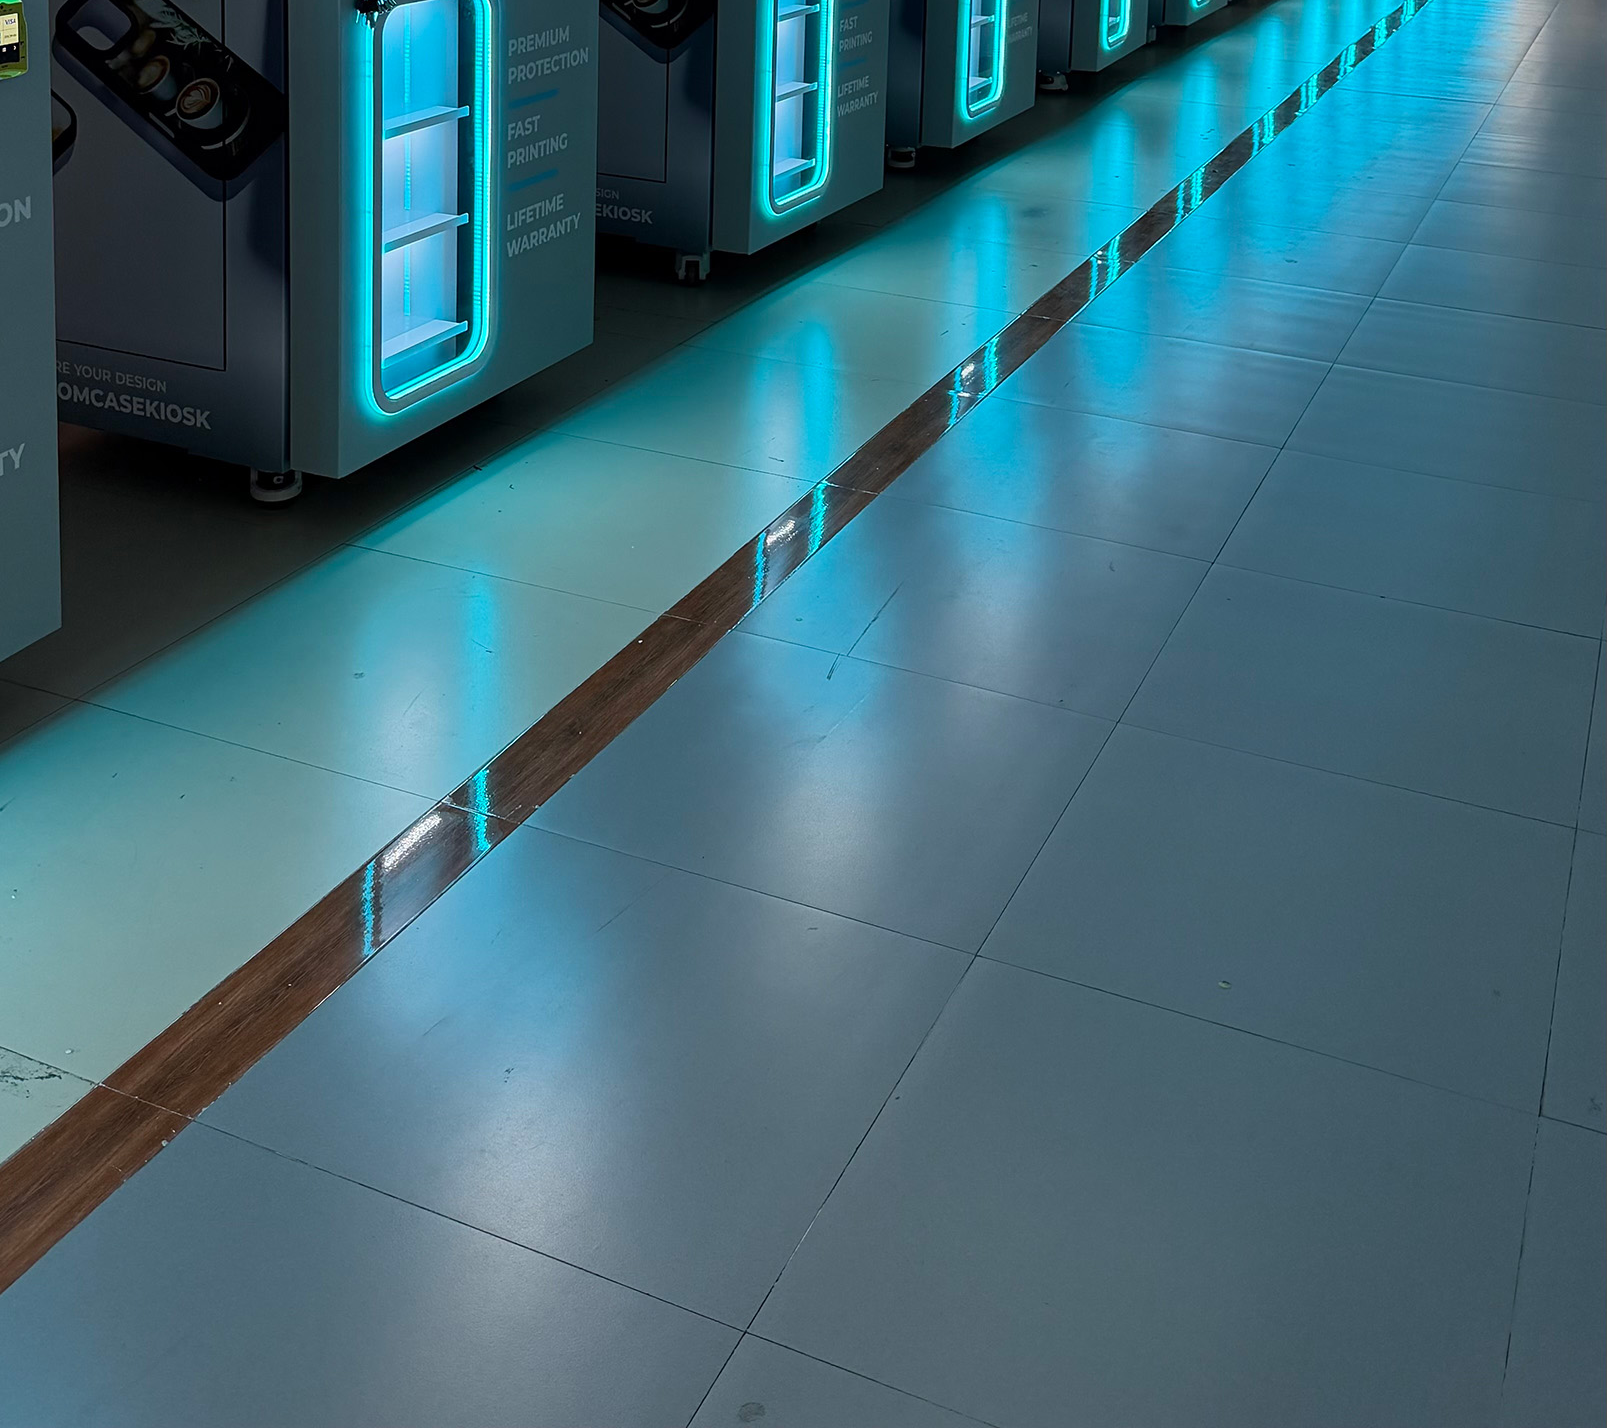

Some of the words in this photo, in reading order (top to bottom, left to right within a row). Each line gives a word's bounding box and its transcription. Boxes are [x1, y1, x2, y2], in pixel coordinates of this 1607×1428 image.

[840, 16, 858, 33] FAST
[508, 25, 570, 57] PREMIUM
[839, 31, 873, 53] PRINTING
[508, 47, 589, 84] PROTECTION
[837, 76, 869, 98] LIFETIME
[836, 91, 879, 118] WARRANTY
[507, 115, 541, 141] FAST
[507, 133, 568, 169] PRINTING
[507, 193, 564, 231] LIFETIME
[506, 212, 581, 258] WARRANTY
[74, 363, 111, 383] YOUR
[116, 372, 167, 393] DESIGN
